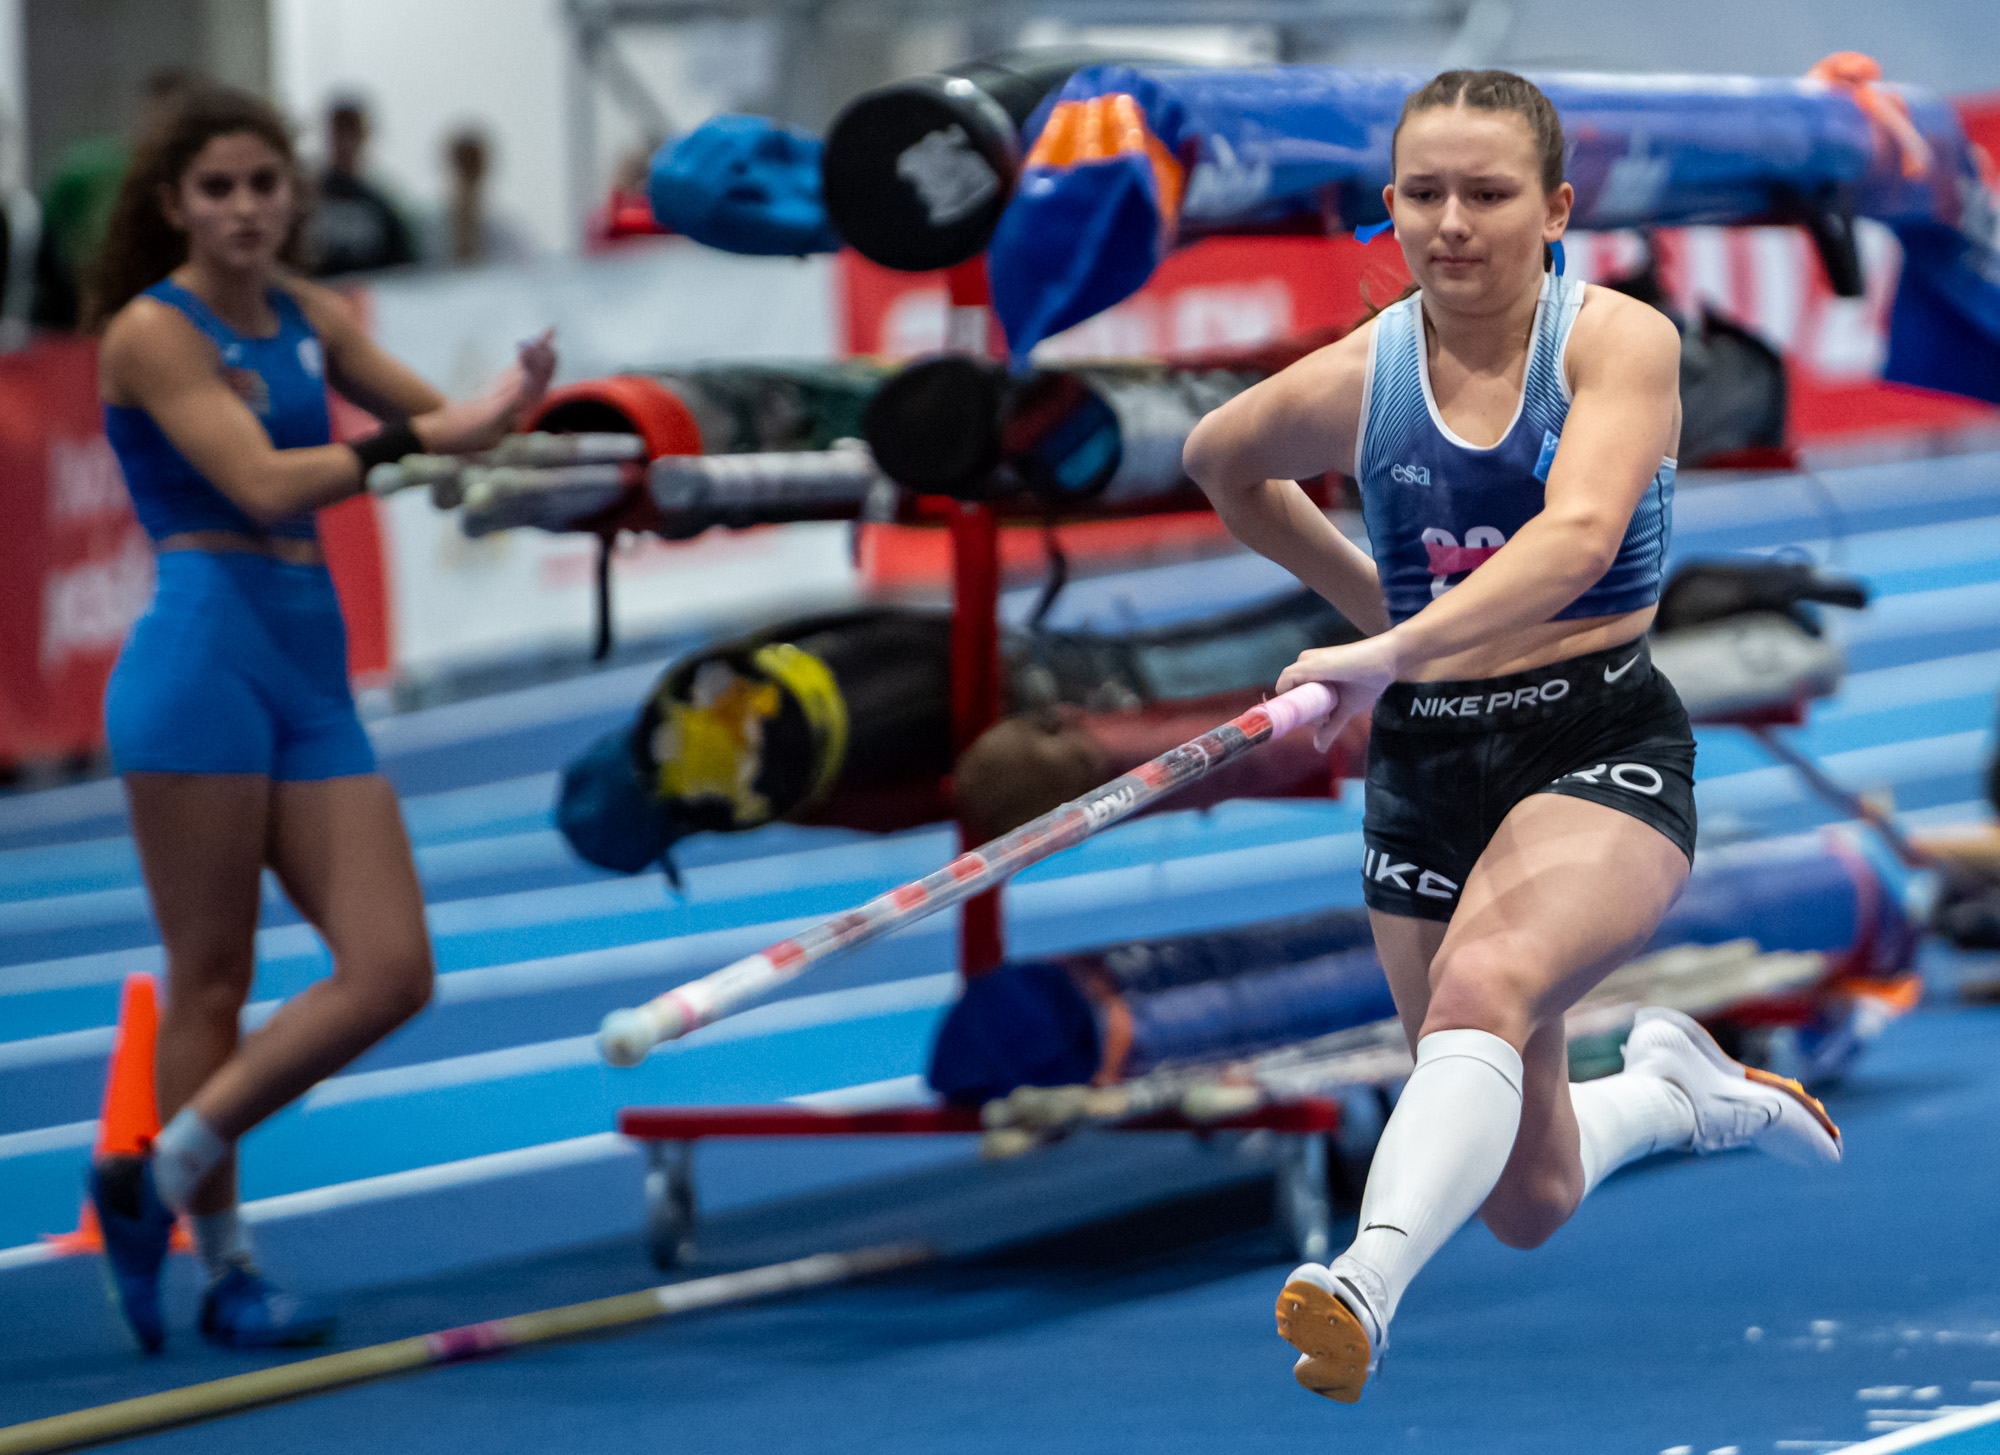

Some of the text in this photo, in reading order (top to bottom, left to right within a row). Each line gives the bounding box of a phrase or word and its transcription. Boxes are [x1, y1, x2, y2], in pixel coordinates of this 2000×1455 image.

[1391, 463, 1431, 486] esa
[1410, 678, 1570, 717] NIKE PRO
[1551, 762, 1663, 795] RO
[1363, 843, 1459, 899] IKE
